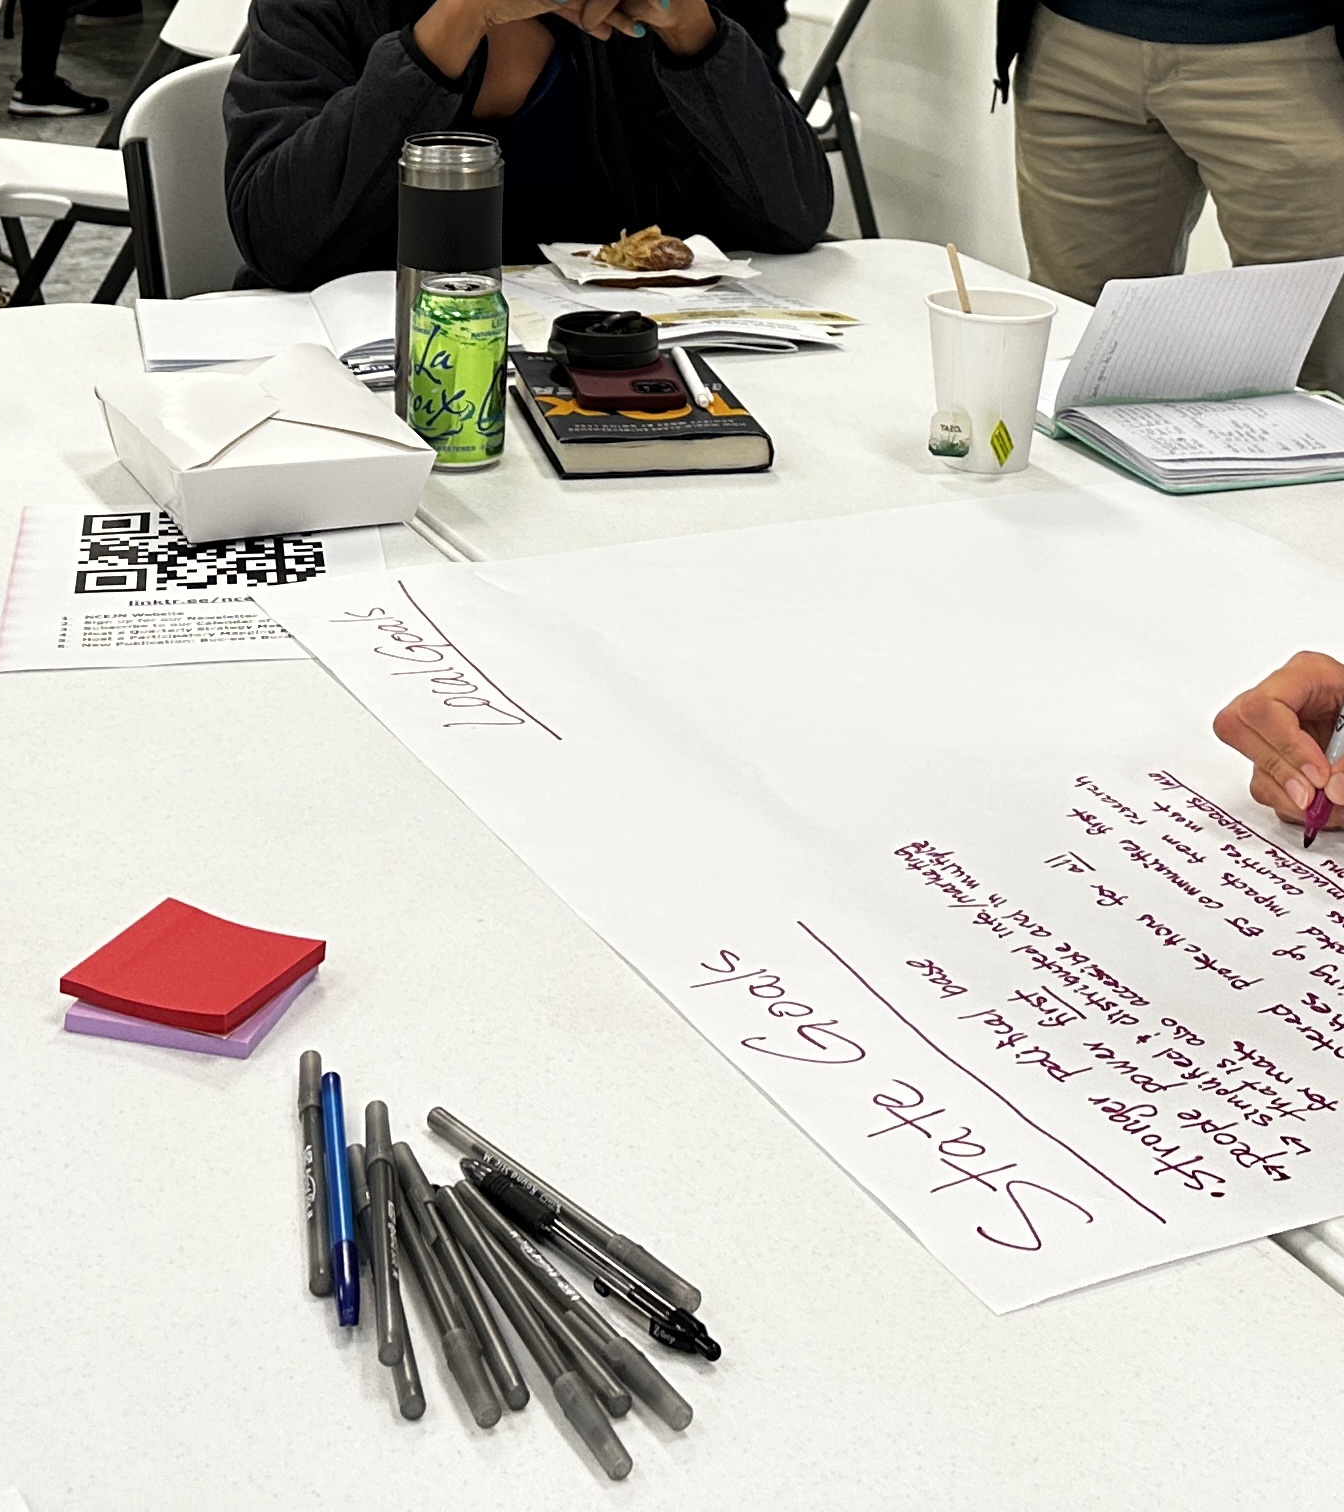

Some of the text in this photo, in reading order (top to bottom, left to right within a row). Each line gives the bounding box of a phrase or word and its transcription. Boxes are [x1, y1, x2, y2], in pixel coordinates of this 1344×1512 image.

[414, 324, 454, 385] La
[1066, 808, 1114, 836] first
[1074, 775, 1148, 825] research
[1152, 801, 1205, 833] most
[1185, 797, 1256, 841] impacts
[1043, 854, 1085, 873] all
[1161, 834, 1207, 864] from
[1219, 843, 1305, 896] counties
[1090, 884, 1129, 907] for
[1118, 839, 1224, 909] communities
[1220, 872, 1291, 918] impacts
[988, 893, 1008, 908] in
[1000, 909, 1053, 938] and
[1223, 917, 1265, 938] EJ
[1135, 913, 1265, 991] protections
[1271, 945, 1307, 961] of
[1010, 944, 1140, 1026] distributed
[1054, 942, 1151, 1007] accessible
[1160, 1017, 1206, 1047] also
[905, 959, 1252, 1191] Stronger political base
[1007, 989, 1289, 1169] people power first
[1151, 1047, 1274, 1127] simplified
[1216, 1057, 1244, 1076] is
[646, 949, 1094, 1252] State Goals
[1241, 1080, 1309, 1122] that
